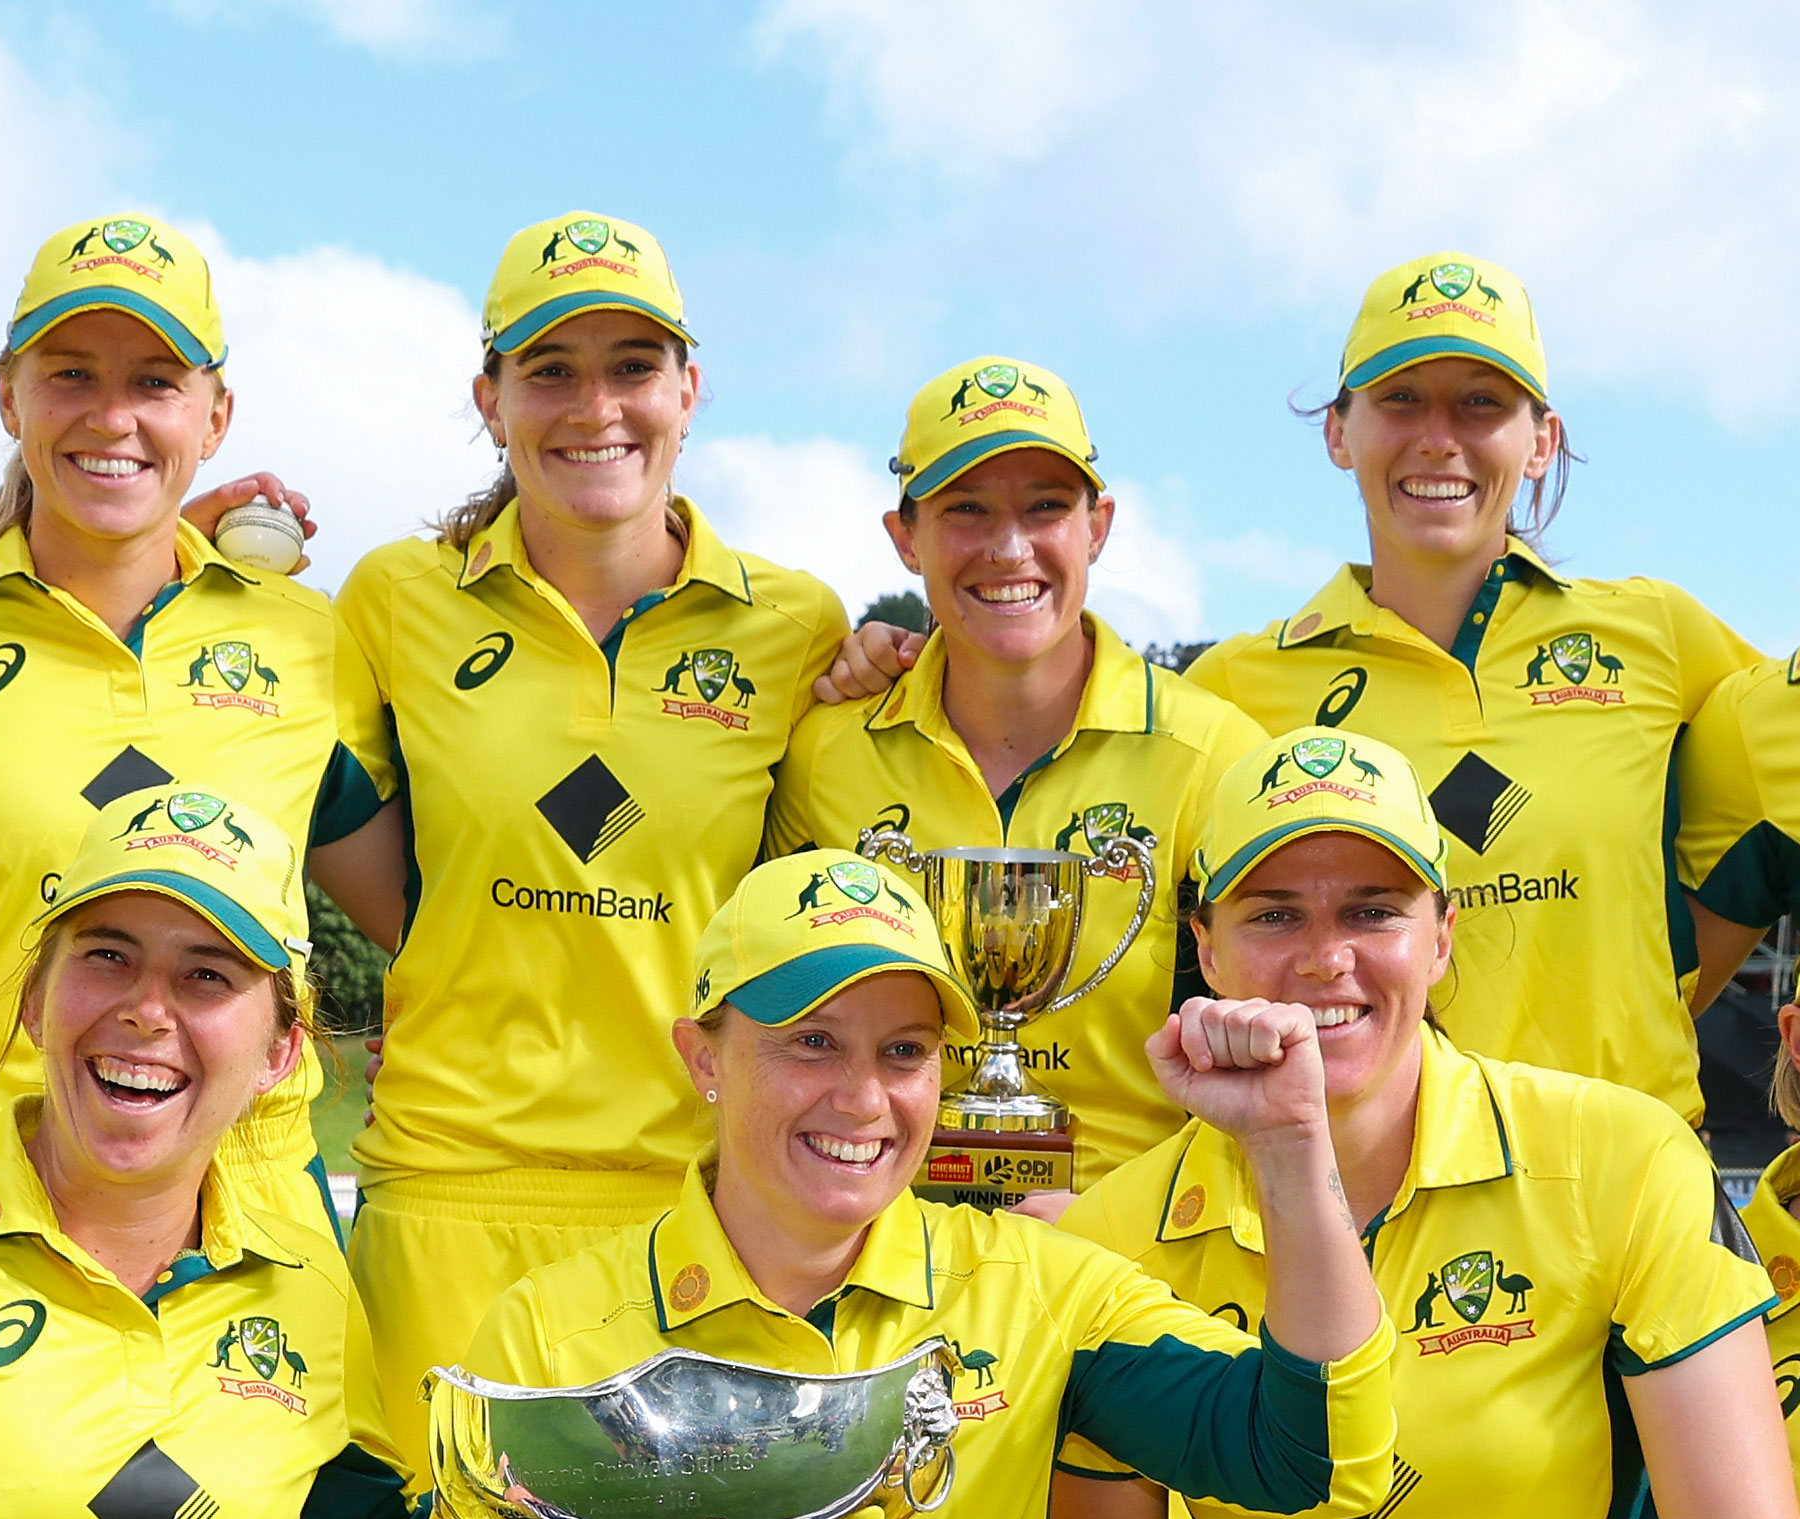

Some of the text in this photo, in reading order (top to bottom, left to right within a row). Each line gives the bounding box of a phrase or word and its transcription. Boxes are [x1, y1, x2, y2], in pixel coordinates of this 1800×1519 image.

[1555, 688, 1604, 701] AUSTRALIA
[686, 704, 731, 724] AUSTRALIA
[1292, 781, 1349, 800] AUSTRALIA
[152, 835, 212, 856] AUSTRALIA
[1448, 868, 1580, 909] mBank
[490, 877, 673, 924] CommBank
[839, 907, 897, 928] AUSTRALIA
[930, 1163, 971, 1174] CHEMIST
[1017, 1159, 1054, 1177] ODI
[1446, 1329, 1506, 1348] AUSTRALIA
[245, 1384, 291, 1405] AUSTRALIA
[516, 1465, 586, 1488] omen's
[680, 1450, 755, 1476] Series
